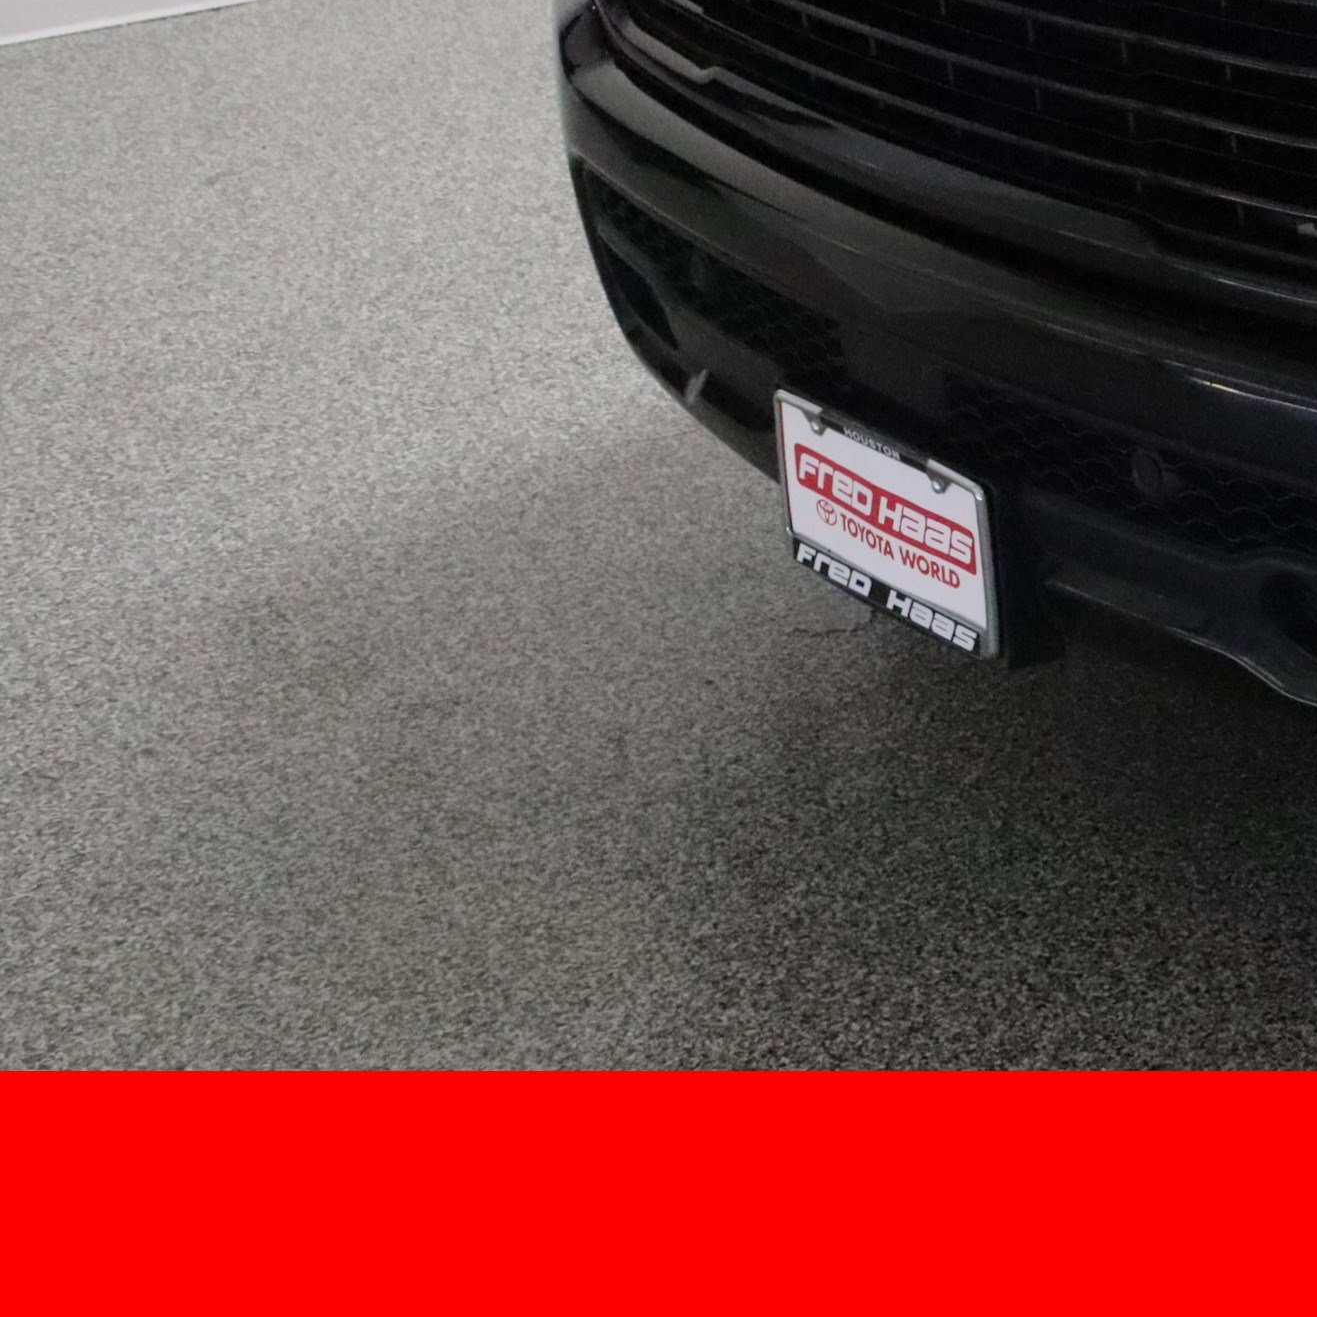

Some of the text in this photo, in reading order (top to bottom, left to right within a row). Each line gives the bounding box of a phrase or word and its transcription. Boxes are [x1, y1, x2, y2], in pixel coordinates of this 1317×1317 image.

[843, 426, 901, 461] HOUSTON
[840, 514, 960, 589] TOYOTA WORLD
